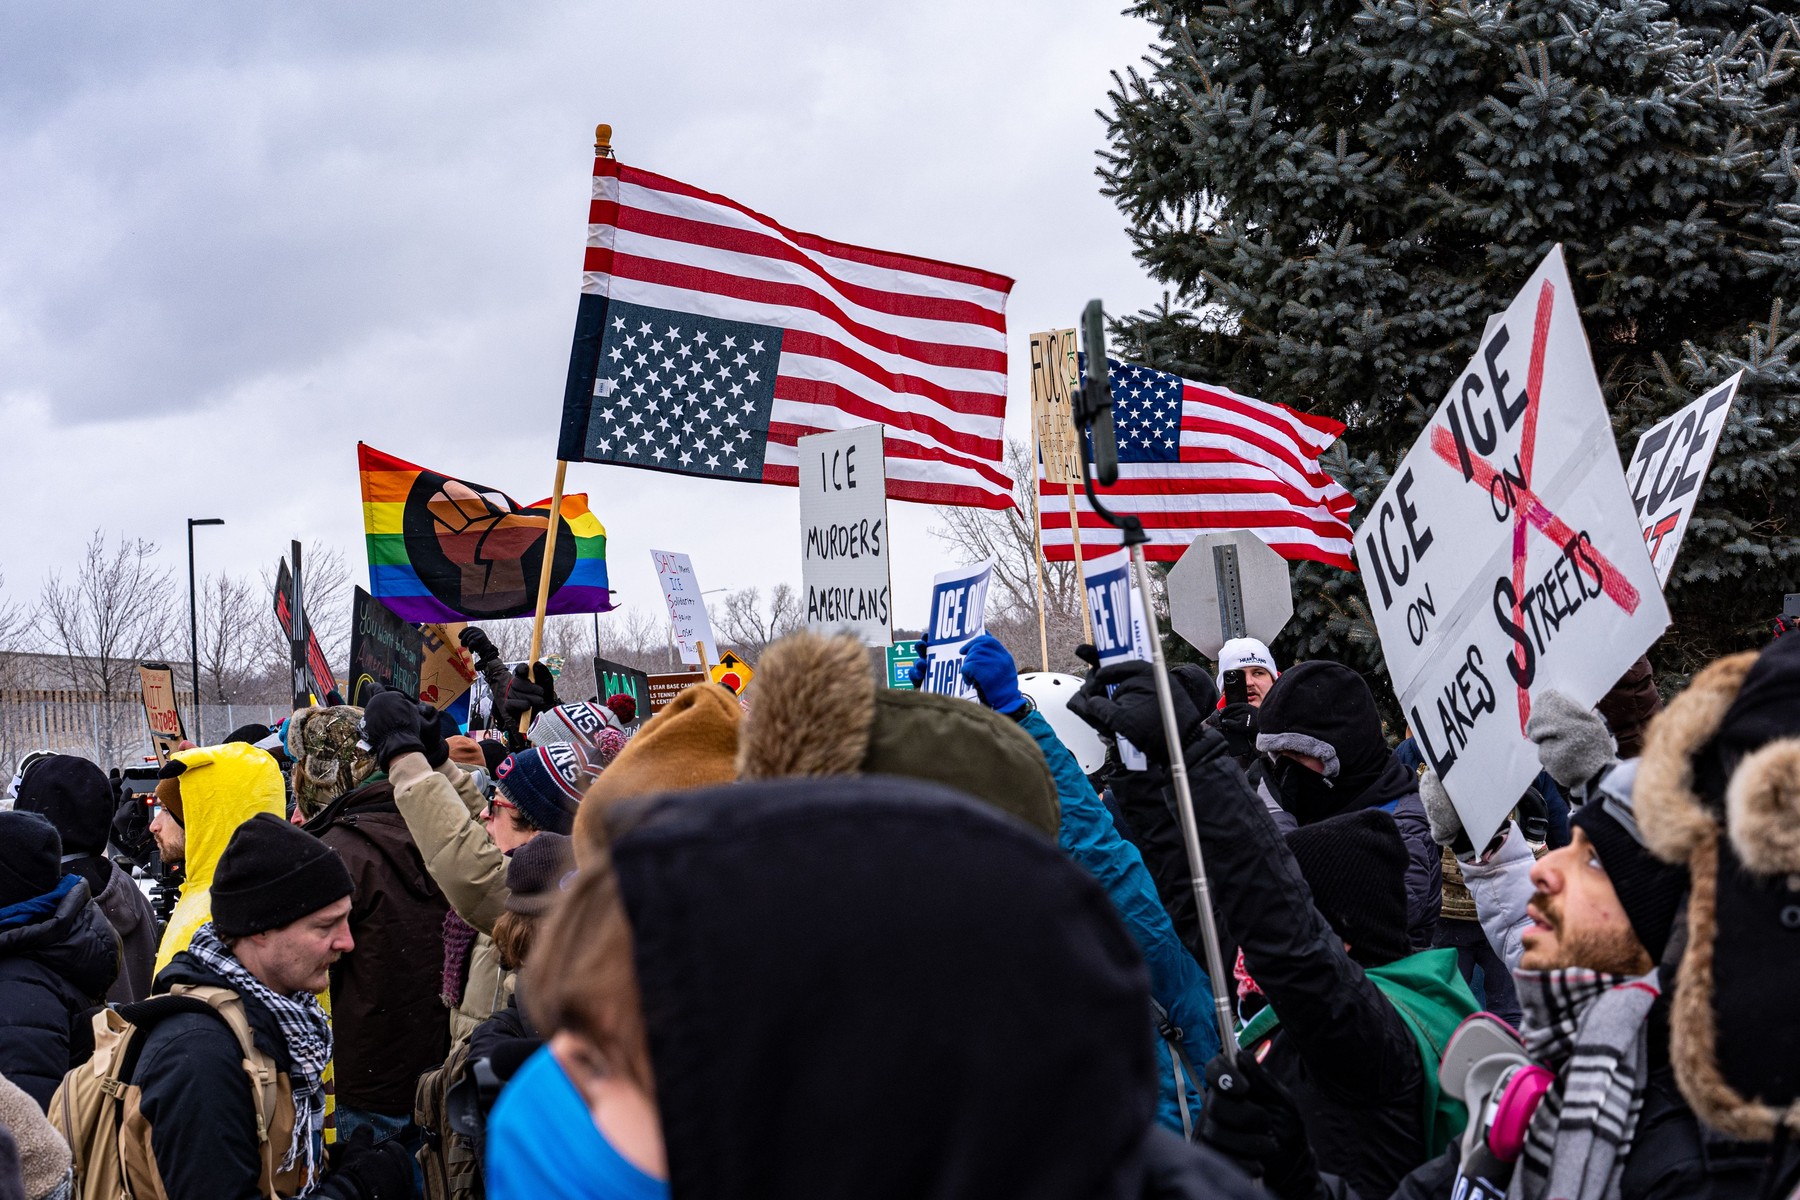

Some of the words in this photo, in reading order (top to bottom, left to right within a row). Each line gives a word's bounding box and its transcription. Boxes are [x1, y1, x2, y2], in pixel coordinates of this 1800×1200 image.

[1031, 335, 1070, 405] FUCK
[1446, 323, 1529, 483] ICE
[821, 444, 857, 493] ICE
[1064, 454, 1081, 480] ALL
[1631, 383, 1733, 518] ICE
[1490, 454, 1526, 523] ON
[655, 553, 679, 574] SALT
[806, 518, 882, 561] MURDERS
[1366, 466, 1434, 611] ICE
[669, 578, 684, 591] ICE
[807, 584, 888, 626] AMERICANS
[935, 587, 965, 640] ICE
[1088, 584, 1116, 652] CE
[1406, 582, 1436, 647] ON
[377, 625, 394, 649] want
[395, 636, 401, 652] to
[401, 639, 408, 658] be
[408, 650, 417, 666] an
[393, 661, 419, 698] HERO?
[926, 653, 976, 697] Fuer
[1411, 644, 1496, 782] LAKES
